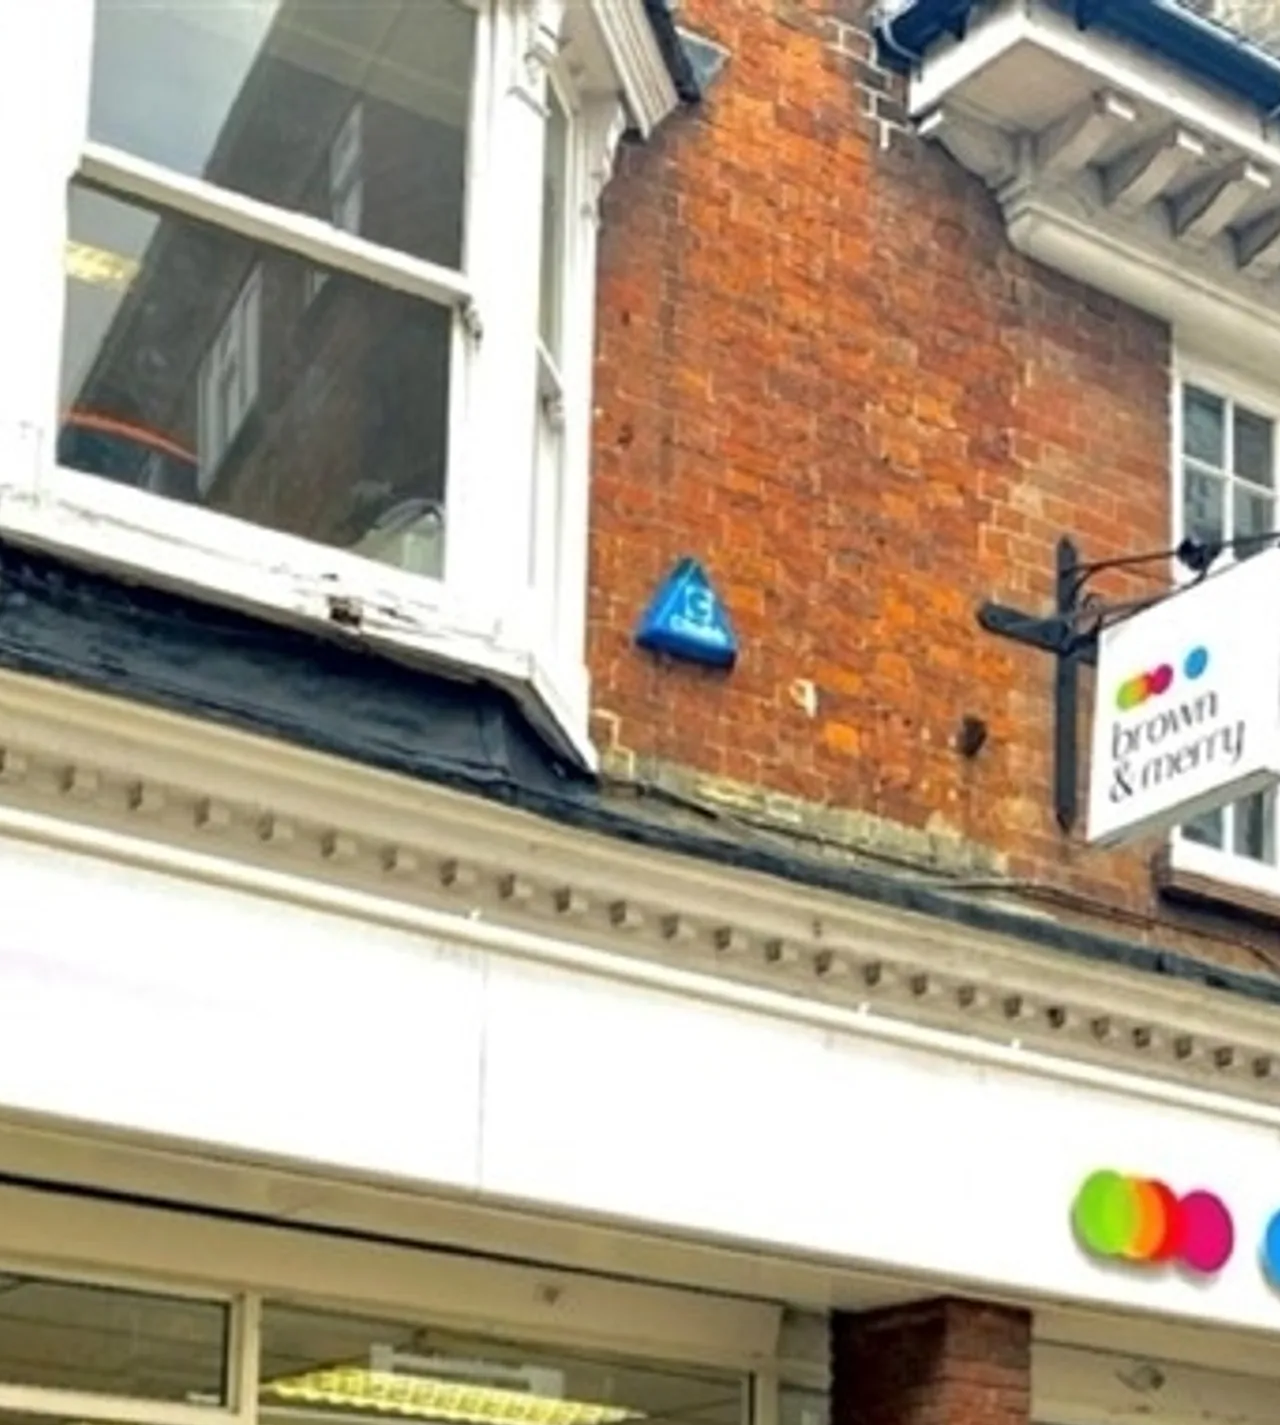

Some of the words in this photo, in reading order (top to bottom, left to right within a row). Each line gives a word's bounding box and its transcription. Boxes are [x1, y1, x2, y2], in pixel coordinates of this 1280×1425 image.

[1109, 760, 1133, 803] &
[1141, 720, 1246, 790] merry
[1112, 689, 1218, 761] brown
